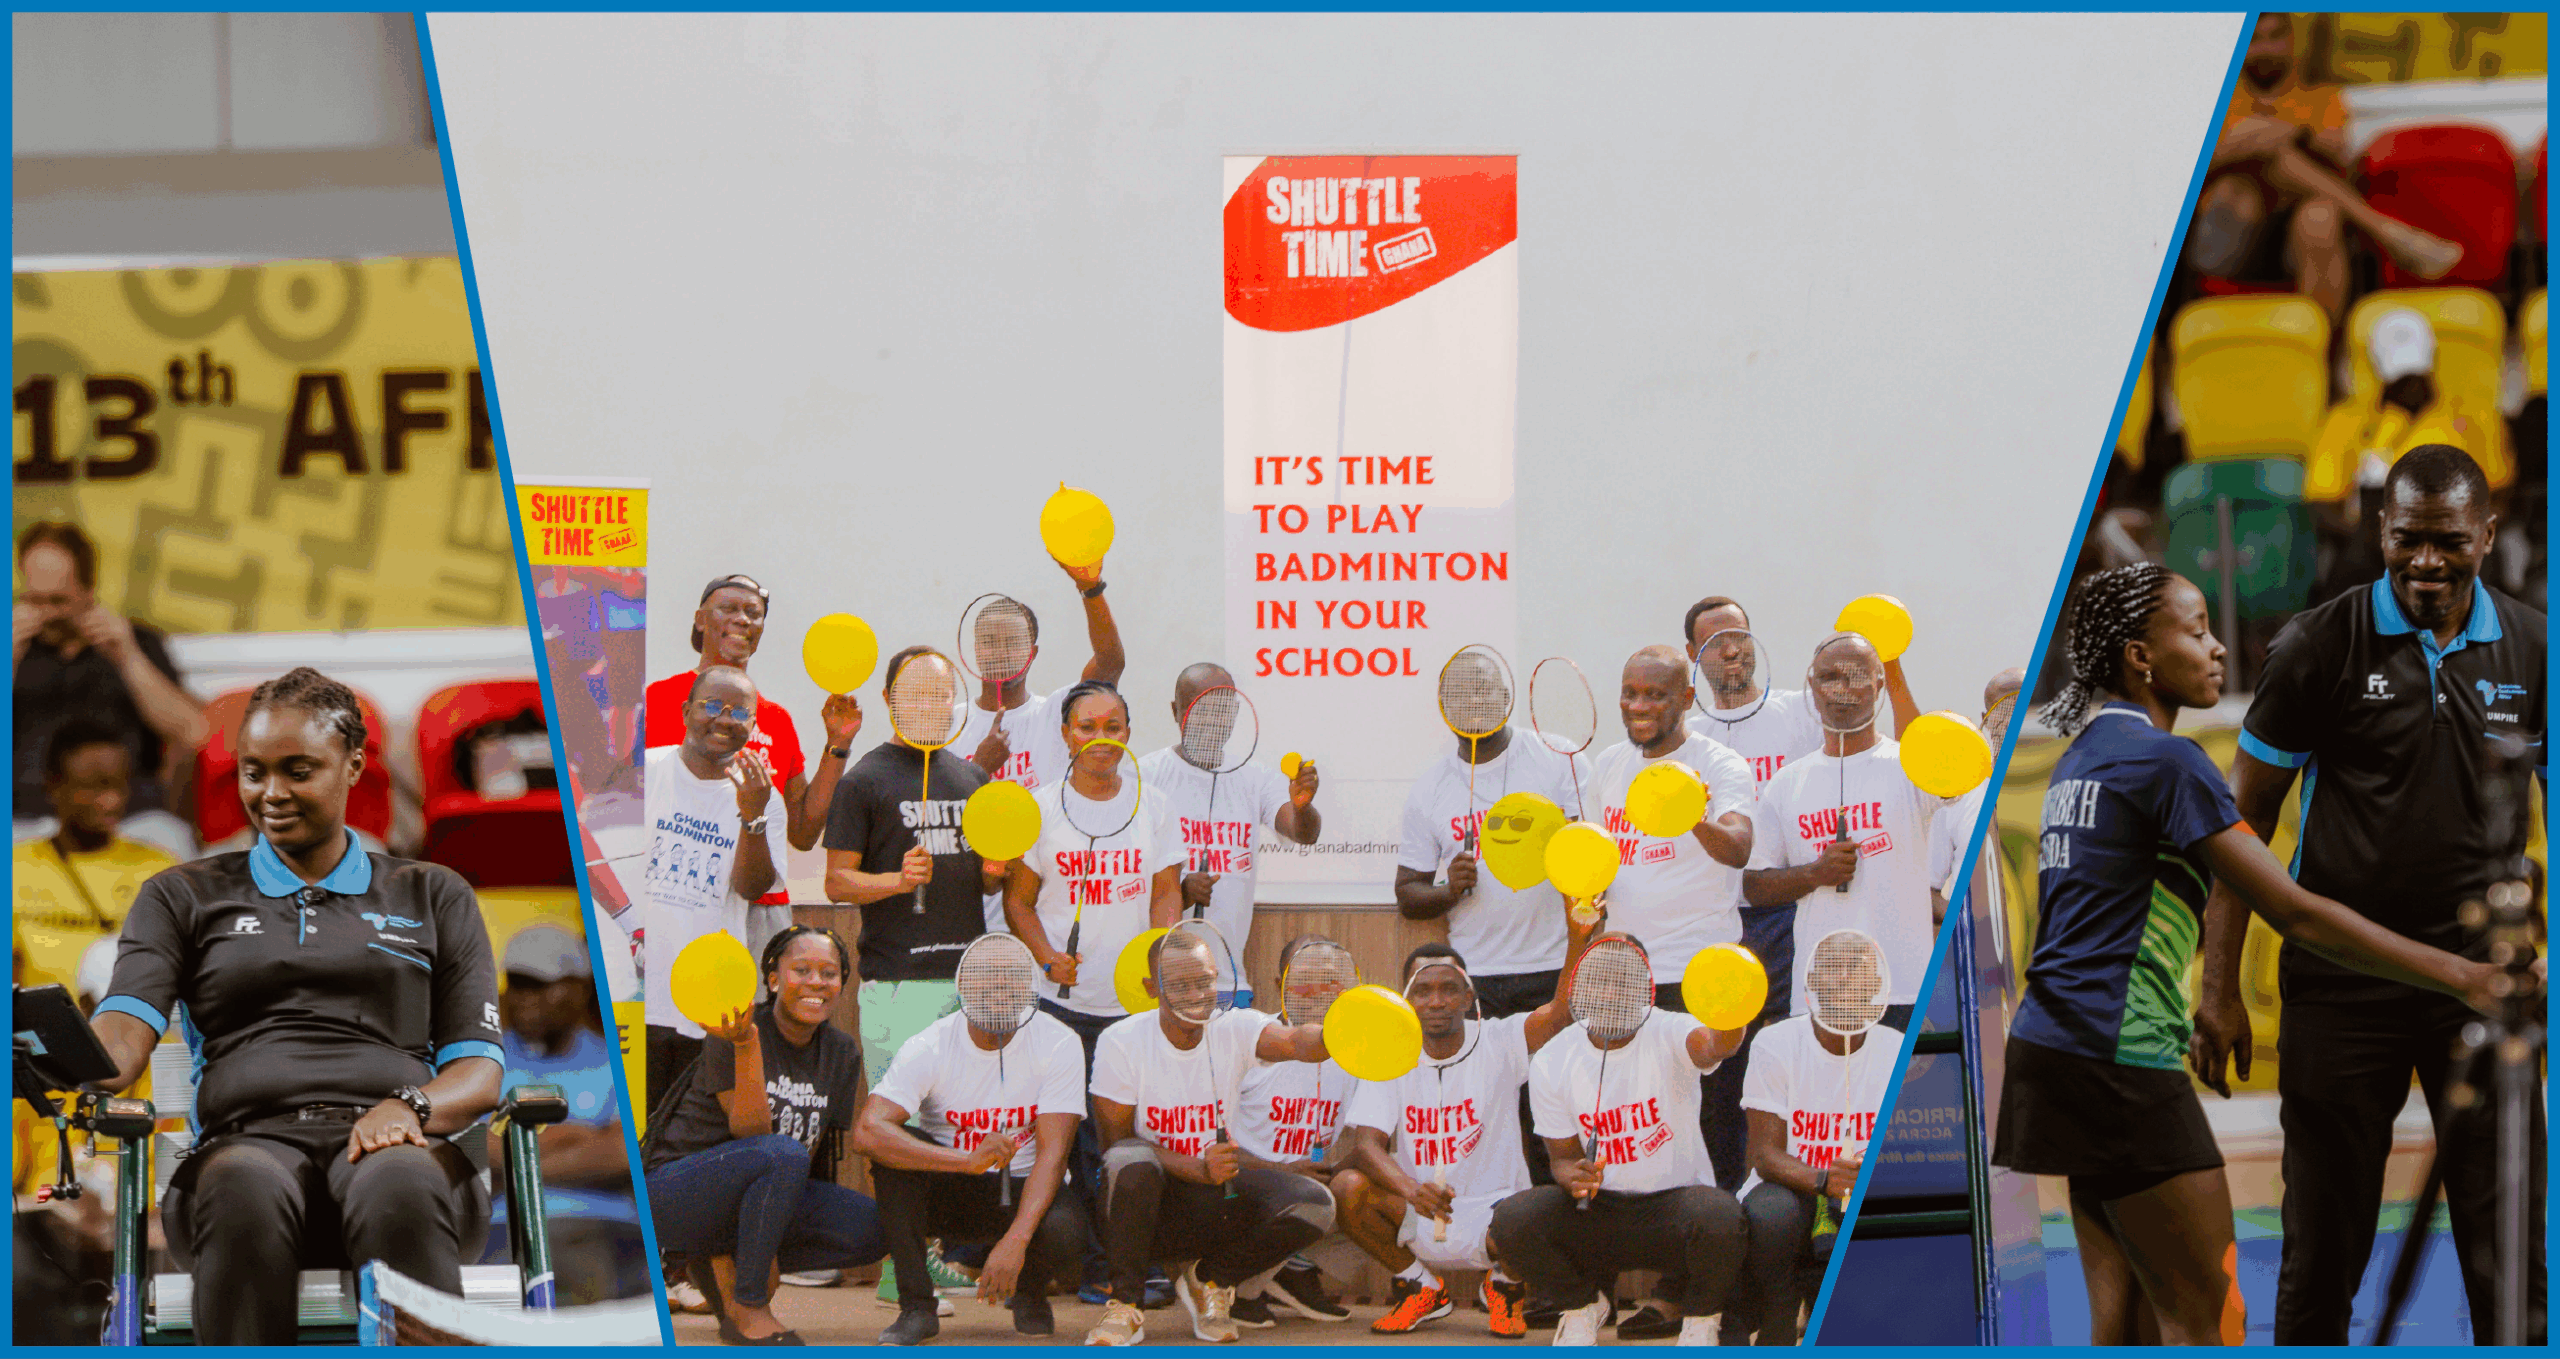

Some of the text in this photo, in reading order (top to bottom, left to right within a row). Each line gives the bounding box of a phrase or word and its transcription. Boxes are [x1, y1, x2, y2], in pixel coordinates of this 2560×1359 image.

[1266, 175, 1422, 227] SHUTTLE
[1281, 229, 1369, 278] TIME
[1254, 455, 1436, 486] IT'S TIME
[530, 492, 629, 525] SHUTTLE
[1252, 503, 1425, 534] TO PLAY
[541, 527, 595, 557] TIME
[1254, 551, 1509, 582] BADMINTON
[1255, 599, 1430, 630] IN YOUR
[1255, 647, 1421, 678] SCHOOL
[2486, 711, 2520, 724] UMPIRE
[655, 818, 736, 851] BADMINTON
[673, 812, 720, 835] GHANA
[1179, 816, 1253, 849] SHUTTLE
[1055, 848, 1143, 878] SHUTTLE
[1273, 1127, 1316, 1157] TIME
